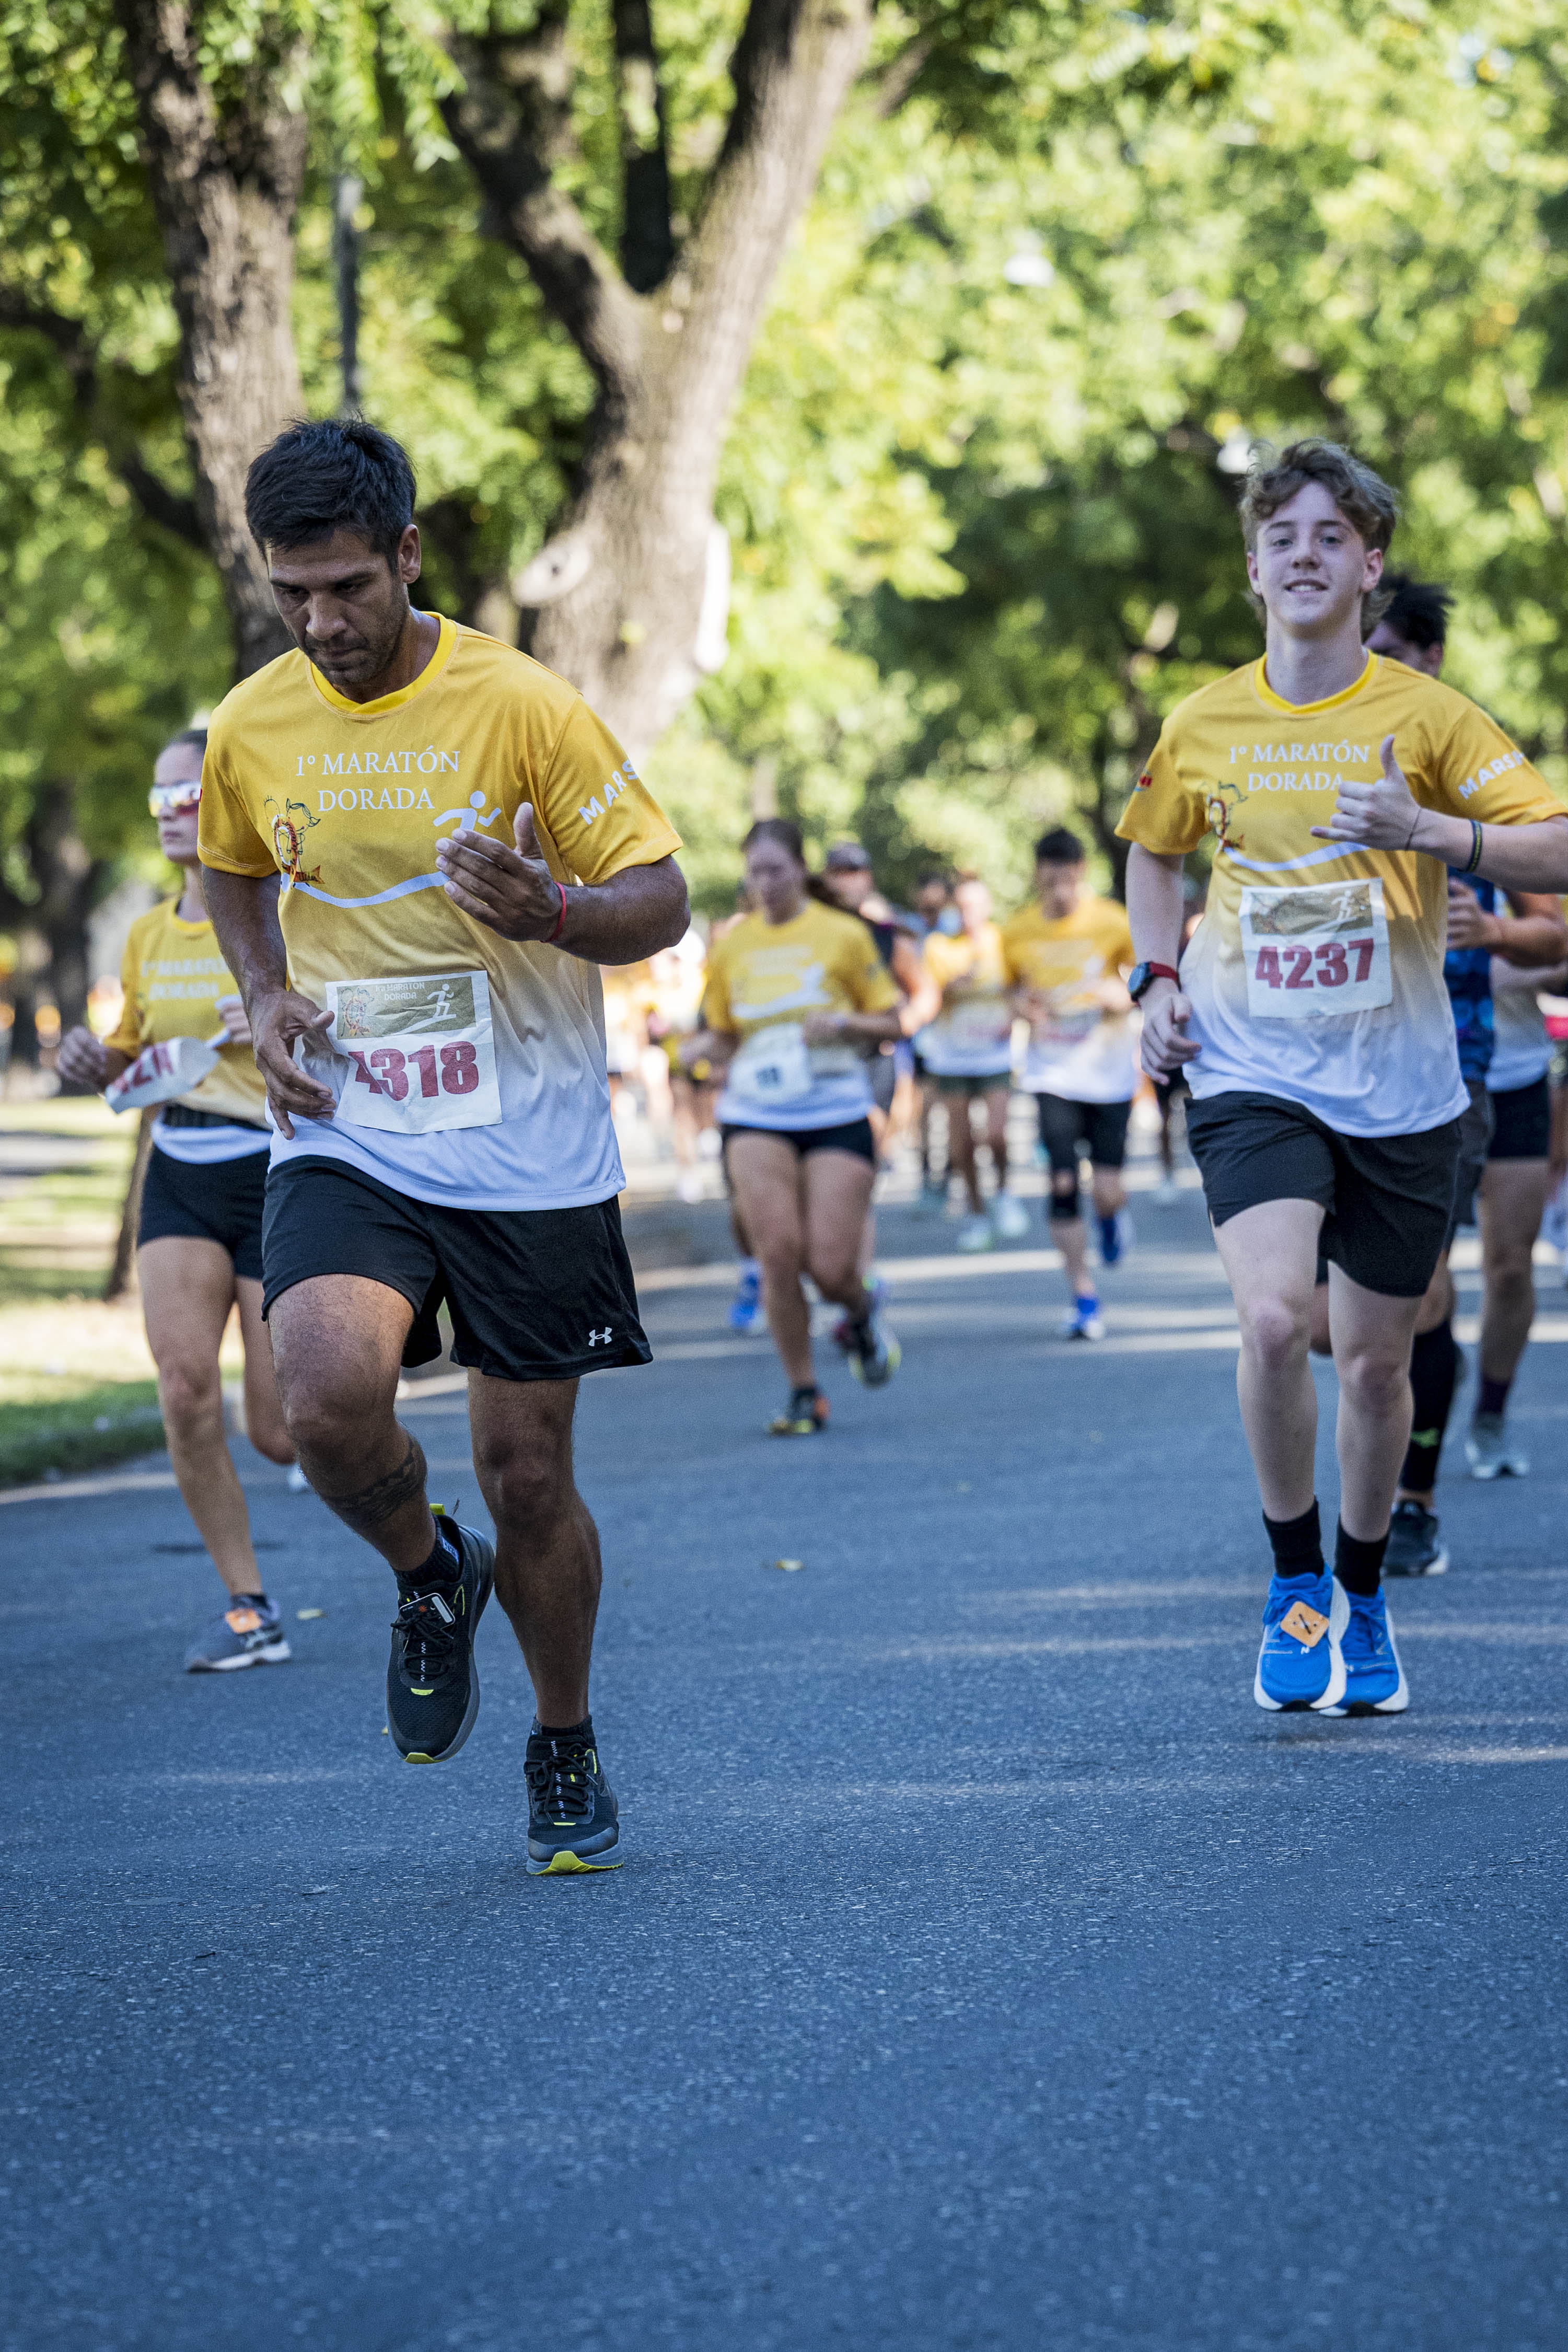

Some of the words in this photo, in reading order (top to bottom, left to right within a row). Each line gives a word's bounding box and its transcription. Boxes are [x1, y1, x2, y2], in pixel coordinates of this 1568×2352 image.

[322, 745, 460, 774] MARATÓN
[1252, 739, 1370, 763] MARATÓN
[1247, 772, 1343, 792] DORADA
[317, 787, 435, 812] DORADA
[1255, 938, 1374, 989] 4237
[348, 1041, 479, 1101] 4318
